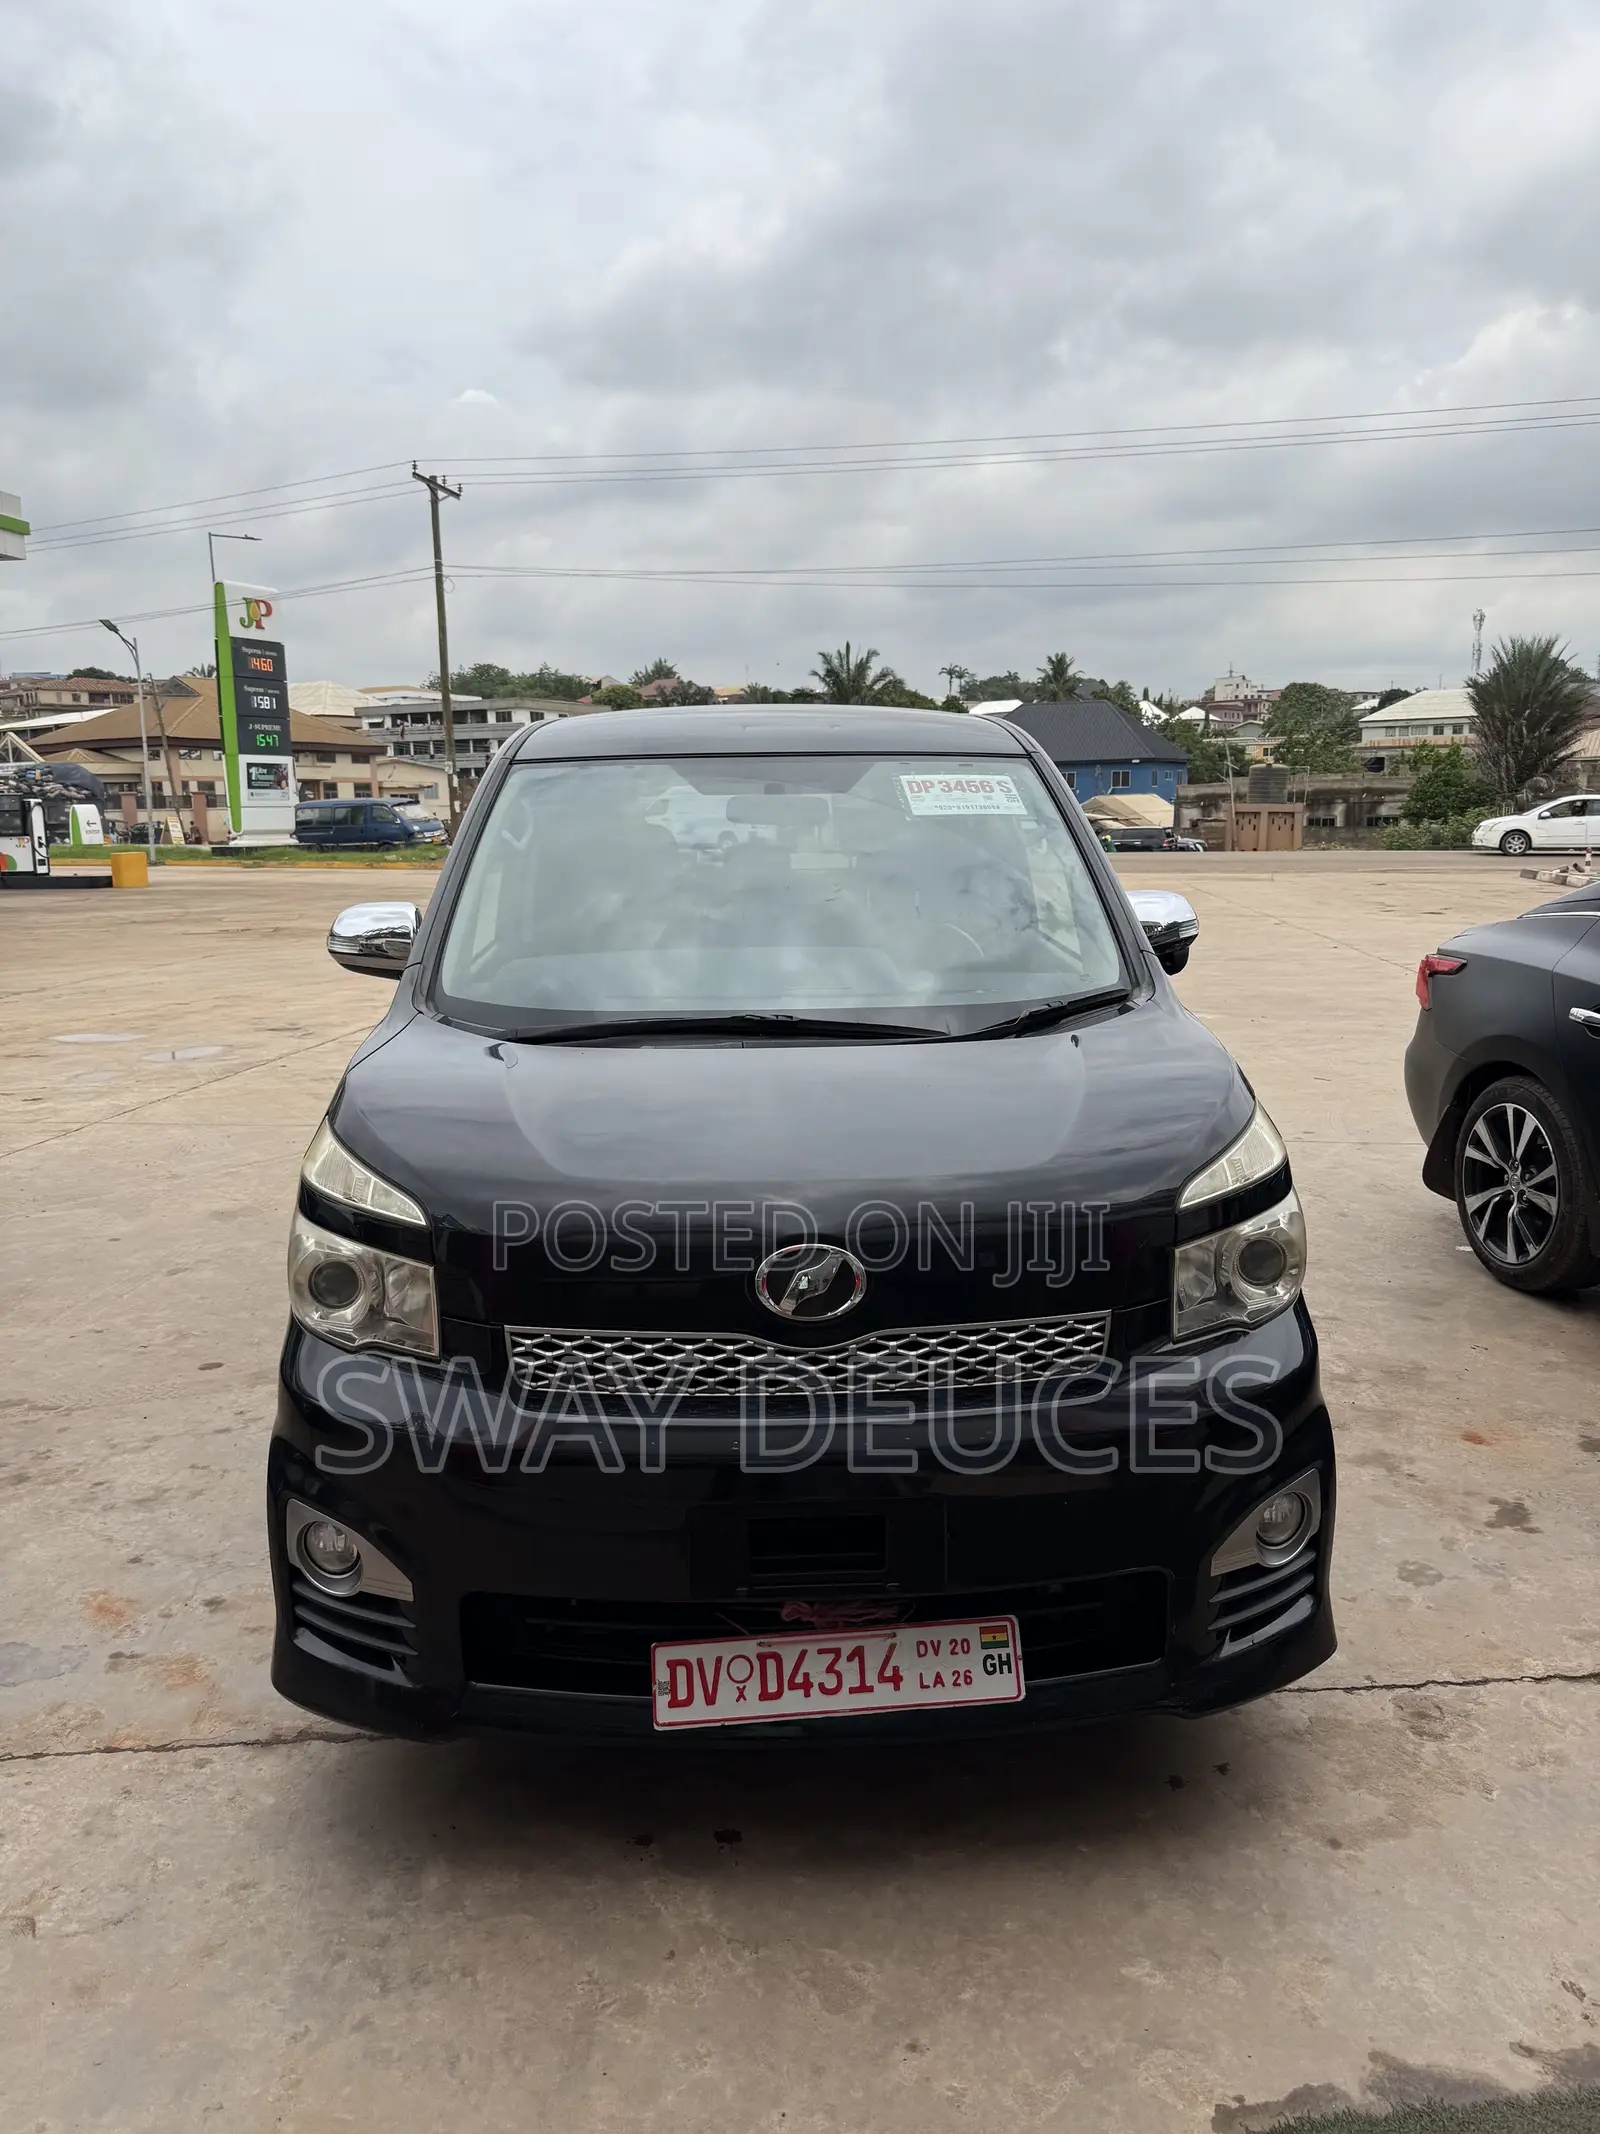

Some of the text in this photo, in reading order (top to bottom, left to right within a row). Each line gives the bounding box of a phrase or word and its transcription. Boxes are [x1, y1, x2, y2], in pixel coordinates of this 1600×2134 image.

[239, 597, 273, 630] JP
[250, 657, 273, 672] 1460
[252, 695, 277, 710] 1581
[256, 733, 279, 747] 1547
[906, 780, 1013, 794] DP 3456 S
[916, 1637, 971, 1658] DV 20
[982, 1652, 1013, 1677] GH
[667, 1655, 722, 1709] DV
[756, 1642, 904, 1702] D4314
[919, 1669, 973, 1689] LA 26
